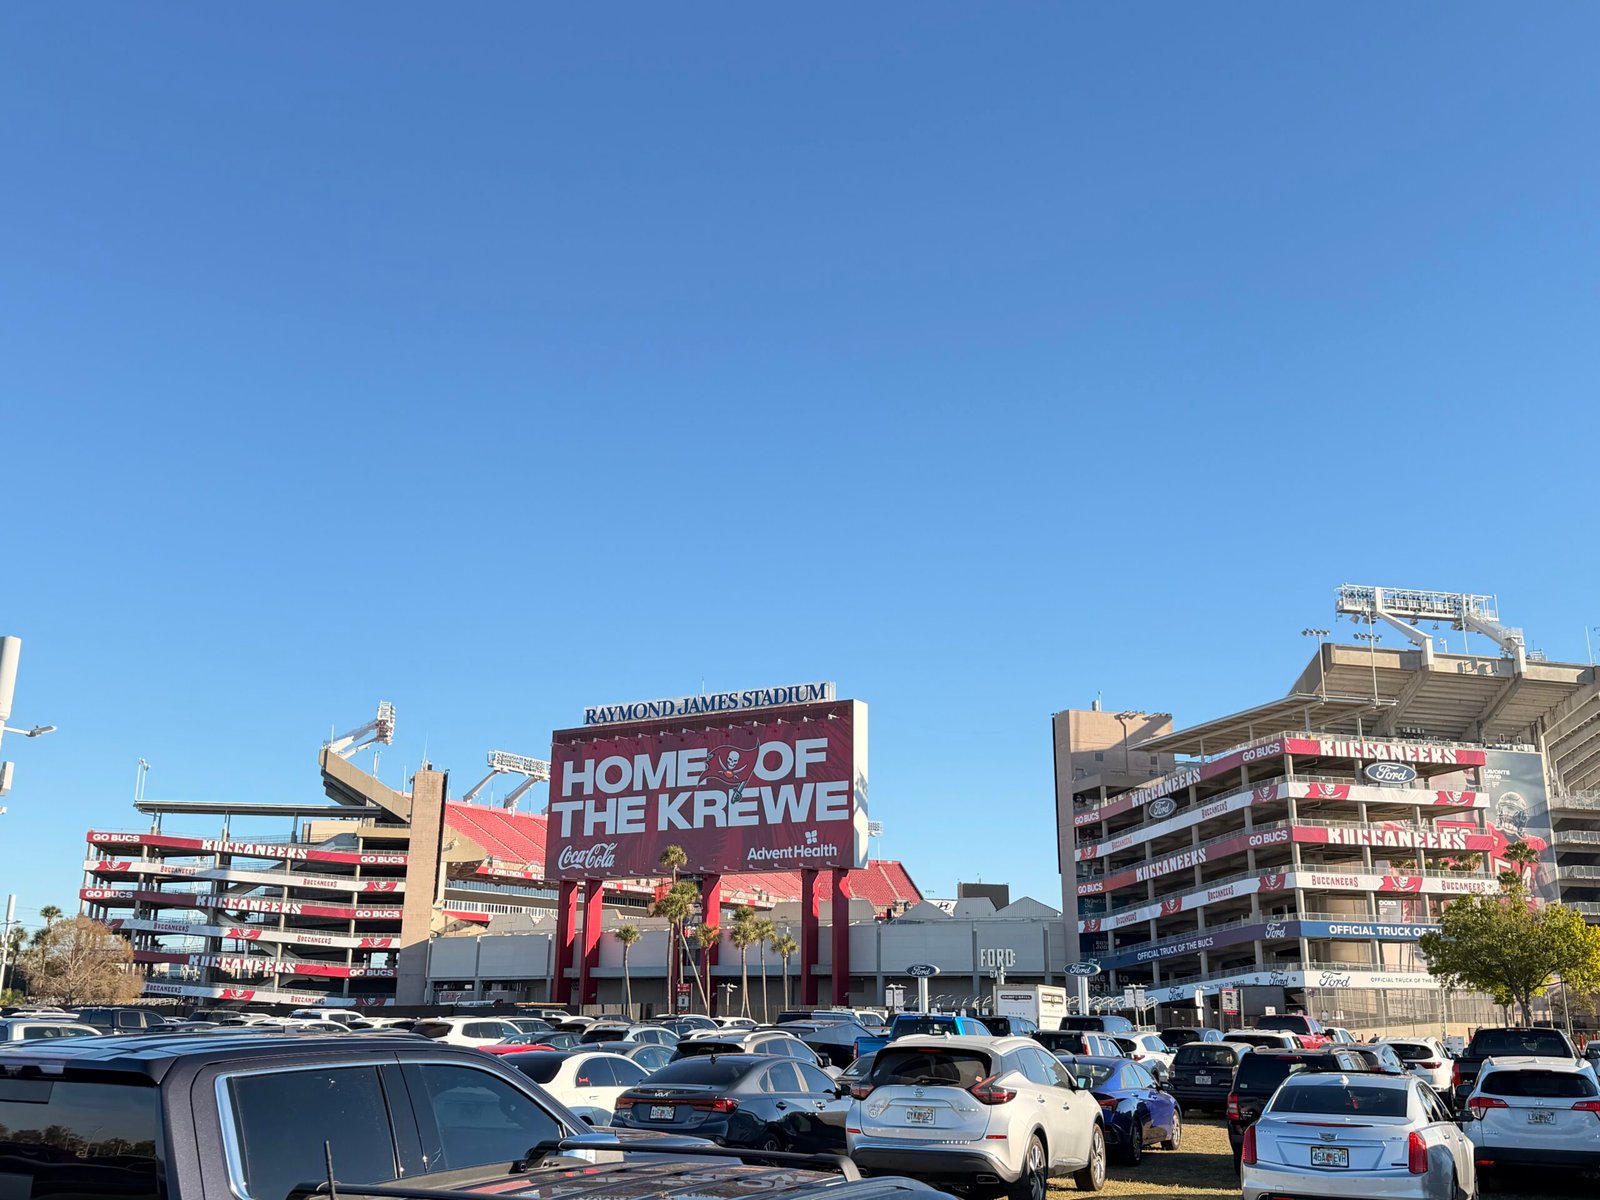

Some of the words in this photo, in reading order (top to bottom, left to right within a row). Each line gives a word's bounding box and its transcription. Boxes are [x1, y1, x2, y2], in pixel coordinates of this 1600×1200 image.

[585, 700, 675, 725] RAYMOND
[677, 693, 738, 714] JAMES
[741, 682, 826, 708] STADIUM
[1243, 751, 1255, 761] GO
[1256, 743, 1281, 757] BUCS
[1320, 739, 1457, 764] BUCCANEERS
[562, 747, 709, 797] HOME
[753, 738, 828, 781] OF
[1376, 764, 1407, 781] Ford
[551, 795, 647, 838] THE
[657, 780, 849, 831] KREWE
[1153, 801, 1171, 816] Ford
[1074, 815, 1084, 825] GO
[1084, 811, 1100, 821] BUCS
[93, 833, 109, 841] GO
[111, 834, 140, 842] BUCS
[1249, 835, 1263, 846] GO
[1263, 830, 1288, 844] BUCS
[1327, 827, 1466, 850] BUCCANEERS
[202, 839, 308, 860] BUCCANEERS
[558, 842, 618, 870] Coca-Cola
[377, 856, 404, 864] BUCS
[1078, 886, 1087, 895] GO
[1087, 882, 1103, 892] BUCS
[1312, 874, 1359, 888] BUCCANEERS
[1441, 880, 1486, 892] BUCCANEERS
[104, 890, 133, 898] BUCS
[373, 910, 400, 918] BUCS
[1265, 922, 1286, 939] Ford
[1329, 924, 1375, 936] OFFICIAL
[1377, 926, 1411, 937] TRUCK
[1413, 927, 1427, 937] OF
[1137, 949, 1159, 961] OFFICIAL
[1159, 946, 1177, 957] TRUCK
[1178, 944, 1186, 953] OF
[1186, 941, 1197, 951] THE
[1197, 937, 1213, 949] BUCS
[980, 949, 1014, 967] FORD
[350, 969, 364, 977] GO
[367, 969, 394, 977] BUCS
[911, 965, 931, 976] Ford
[1069, 964, 1092, 974] Ford
[1319, 971, 1351, 988] Ford
